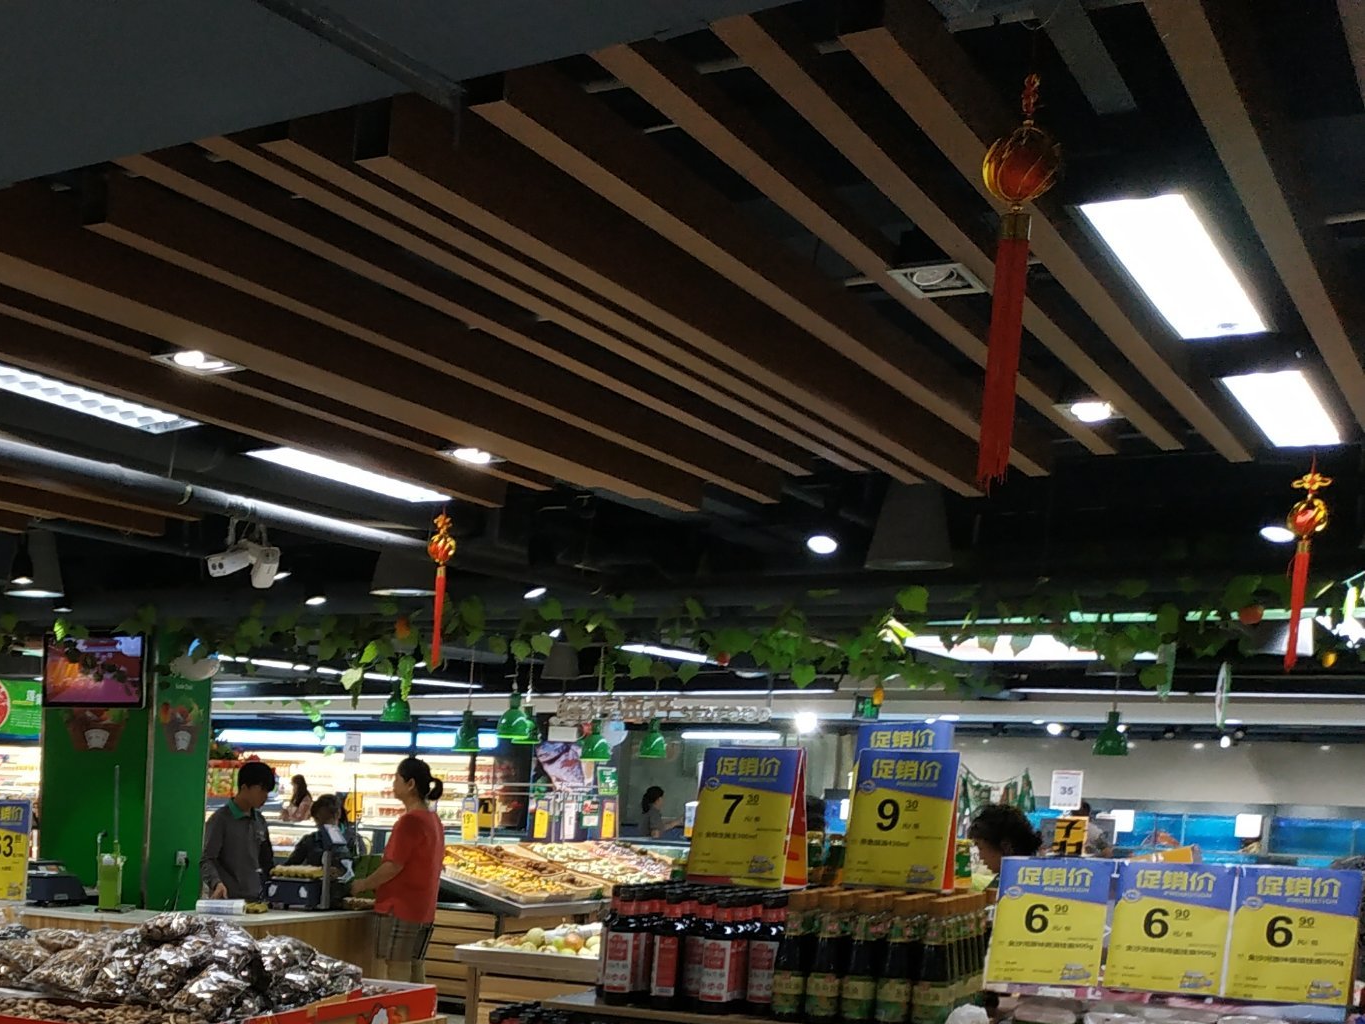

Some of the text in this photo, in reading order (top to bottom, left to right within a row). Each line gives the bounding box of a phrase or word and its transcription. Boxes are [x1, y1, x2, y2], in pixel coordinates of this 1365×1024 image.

[870, 729, 935, 748] 促销价
[716, 756, 782, 776] 促销价
[872, 758, 942, 781] 促销价
[1060, 786, 1074, 795] 35
[723, 794, 744, 825] 7
[876, 798, 919, 832] 9 30
[1017, 866, 1093, 887] 促销价
[1136, 869, 1216, 892] 促销价
[1257, 875, 1342, 897] 促销价
[1025, 904, 1069, 934] 6 90
[1143, 908, 1190, 939] 6 90
[1266, 915, 1315, 948] 6 90
